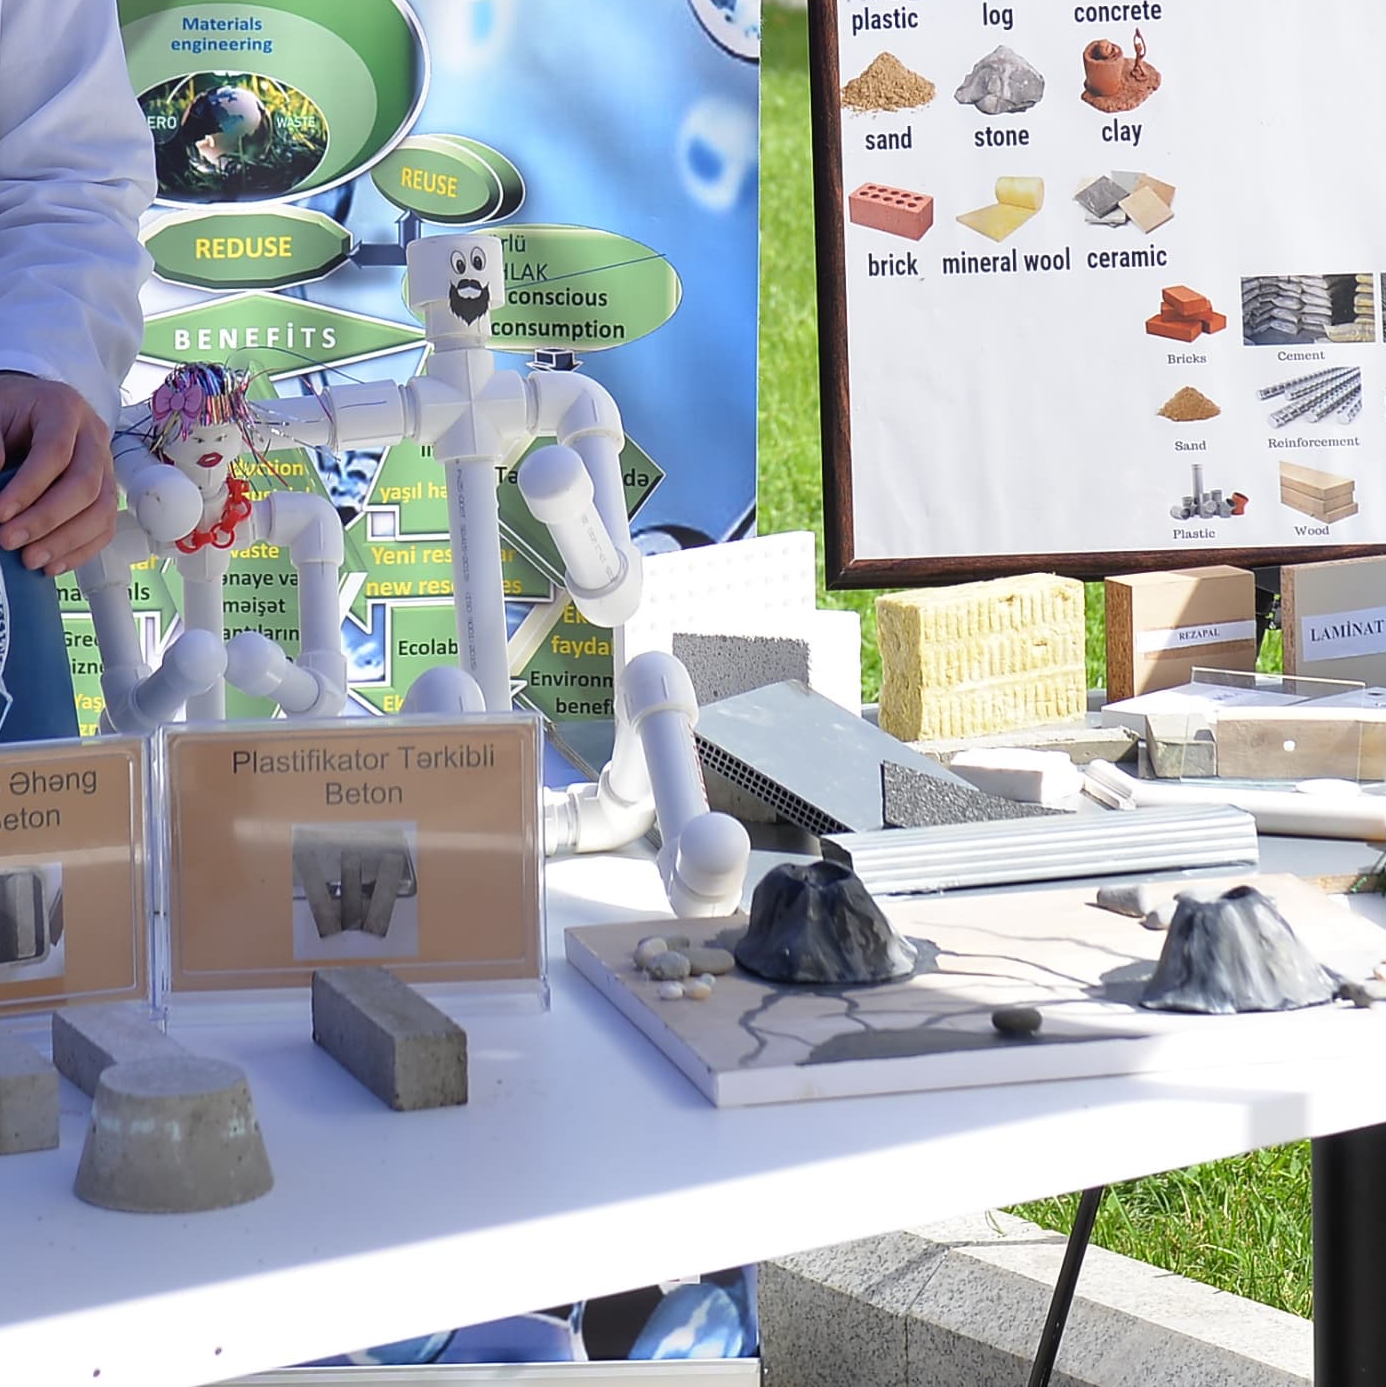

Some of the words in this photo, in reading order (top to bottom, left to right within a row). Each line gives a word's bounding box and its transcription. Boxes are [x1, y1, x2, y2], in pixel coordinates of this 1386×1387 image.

[852, 7, 919, 35] plastic
[983, 2, 1014, 30] log
[1074, 0, 1162, 22] concrete
[182, 16, 263, 32] Materials
[171, 37, 273, 54] engineering
[276, 115, 317, 129] WASTE
[1101, 118, 1143, 146] clay
[865, 126, 913, 150] sand
[974, 126, 1030, 147] stone
[401, 166, 459, 199] REUSE
[196, 236, 292, 260] REDUSE
[1087, 245, 1168, 268] ceramic
[868, 253, 918, 276] brick
[942, 249, 1017, 274] mineral
[1023, 246, 1071, 271] wool
[508, 288, 608, 307] conscious
[174, 322, 337, 351] BENEFİTS
[491, 320, 626, 340] consumption
[1167, 354, 1207, 365] Bricks
[1277, 351, 1325, 362] Cement
[1174, 441, 1207, 451] Sand
[1268, 437, 1361, 450] Reinforcement
[380, 482, 422, 503] yaşıl
[1173, 528, 1216, 540] Plastic
[1294, 525, 1330, 536] Wood
[371, 546, 416, 565] Yeni
[365, 581, 409, 596] new
[1179, 628, 1220, 641] REZAPAL
[1310, 620, 1385, 642] LAMİNAT
[233, 750, 391, 775] Plastifikator
[398, 745, 495, 770] Tərkibli
[9, 770, 98, 797] Əhəng
[325, 781, 404, 805] Beton
